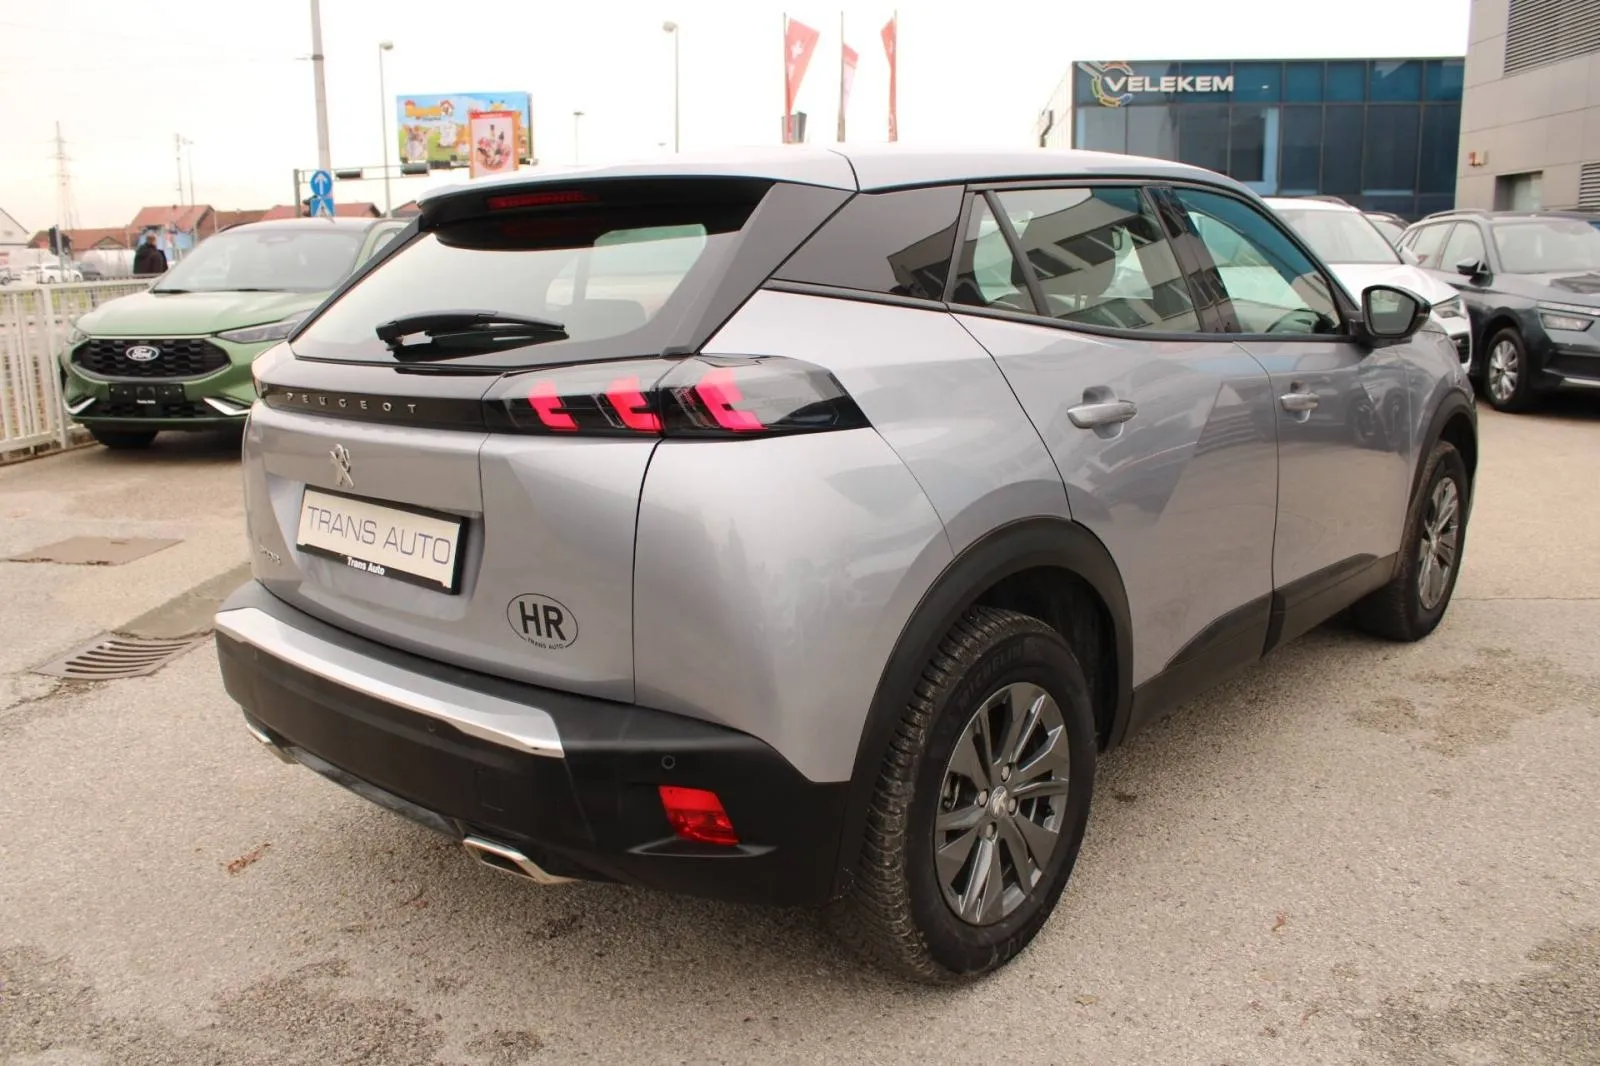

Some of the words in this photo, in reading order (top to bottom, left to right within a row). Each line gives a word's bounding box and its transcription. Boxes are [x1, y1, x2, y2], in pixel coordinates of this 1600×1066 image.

[1104, 75, 1234, 92] VELEKEM
[286, 392, 416, 414] PEUGEOT
[307, 505, 377, 545] TRANS
[383, 526, 451, 565] AUTO
[347, 557, 367, 572] Trans
[367, 560, 385, 576] Auto
[519, 600, 567, 641] HR
[527, 637, 547, 649] TRANS
